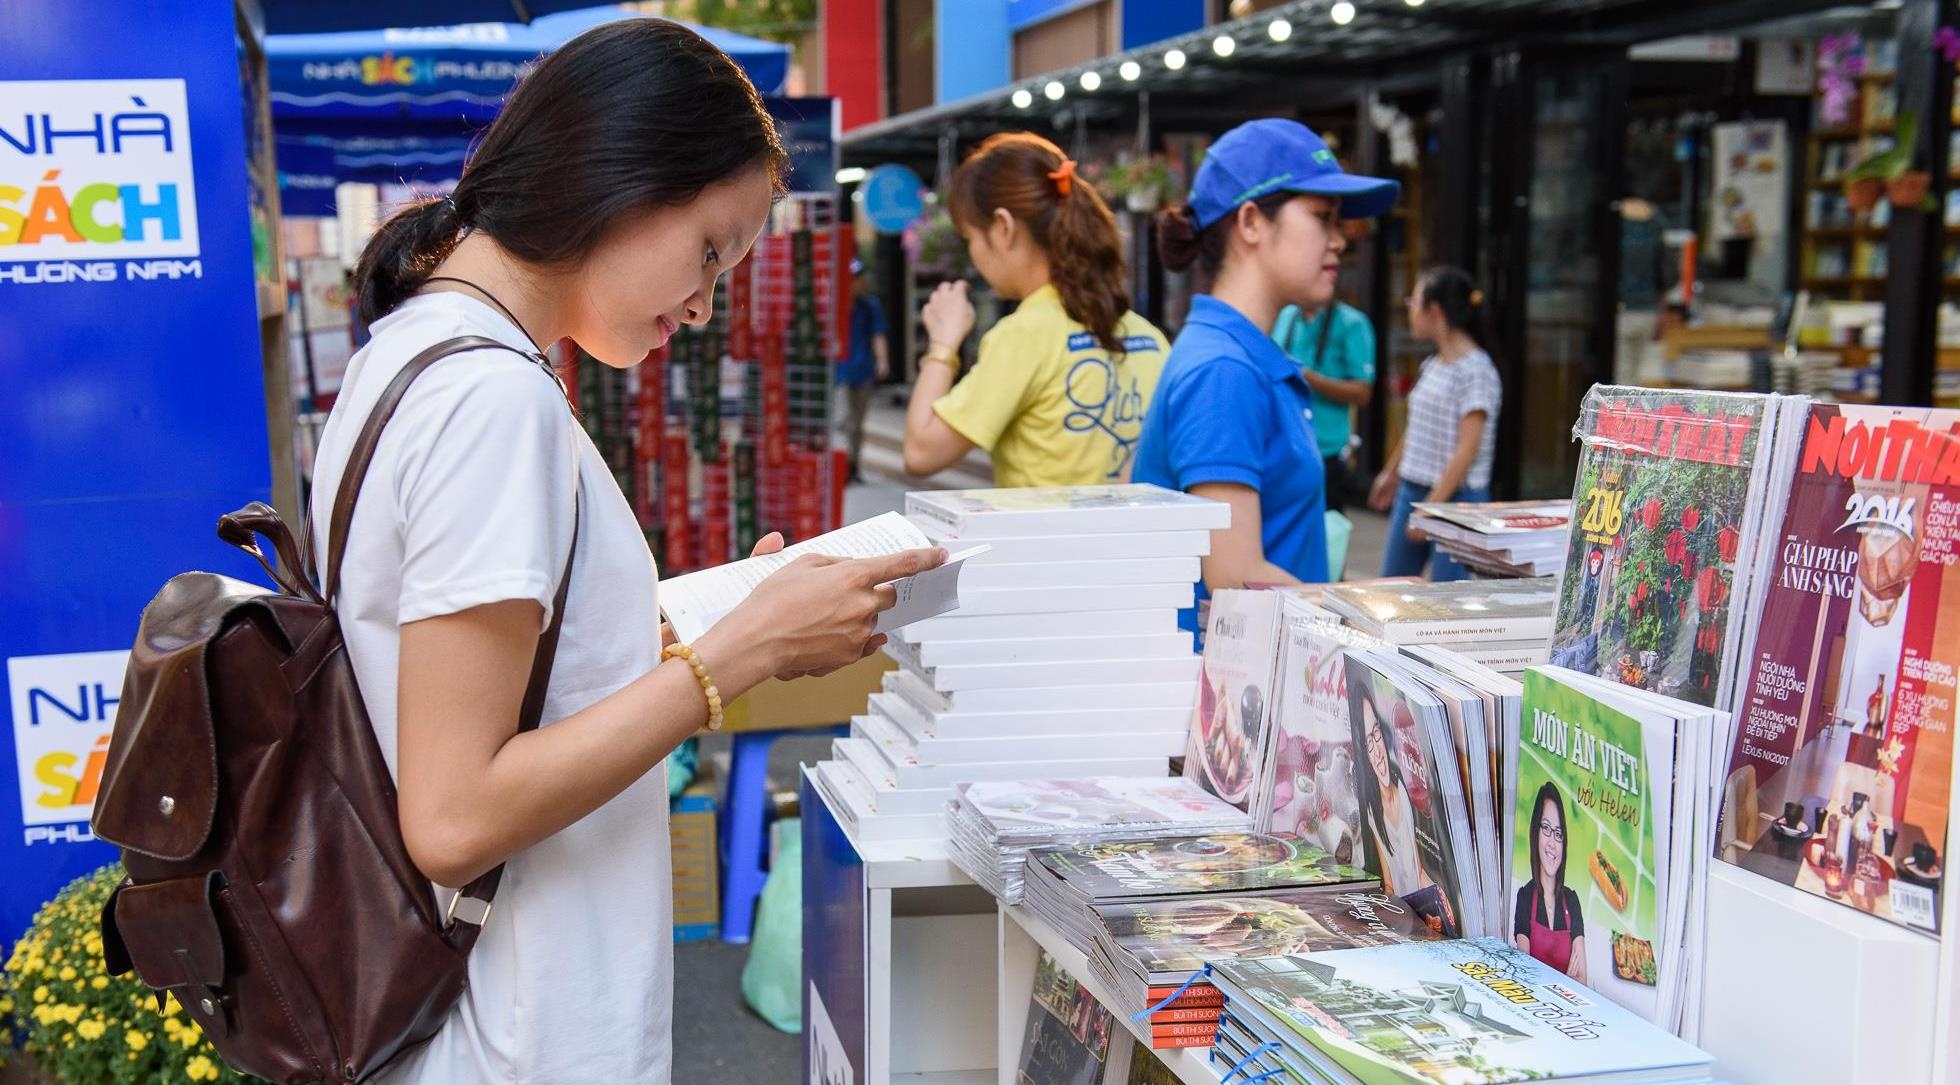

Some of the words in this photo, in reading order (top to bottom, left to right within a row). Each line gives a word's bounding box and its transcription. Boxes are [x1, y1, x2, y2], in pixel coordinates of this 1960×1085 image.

[126, 260, 202, 281] NAM
[1582, 487, 1624, 536] 2016
[1840, 493, 1916, 537] 2016
[1815, 546, 1858, 573] PHÁP
[1532, 707, 1569, 759] MÓN
[1572, 720, 1597, 774] ĂN
[1600, 739, 1639, 798] VIỆT
[1600, 789, 1640, 828] Helen
[1481, 978, 1541, 1005] Màu
